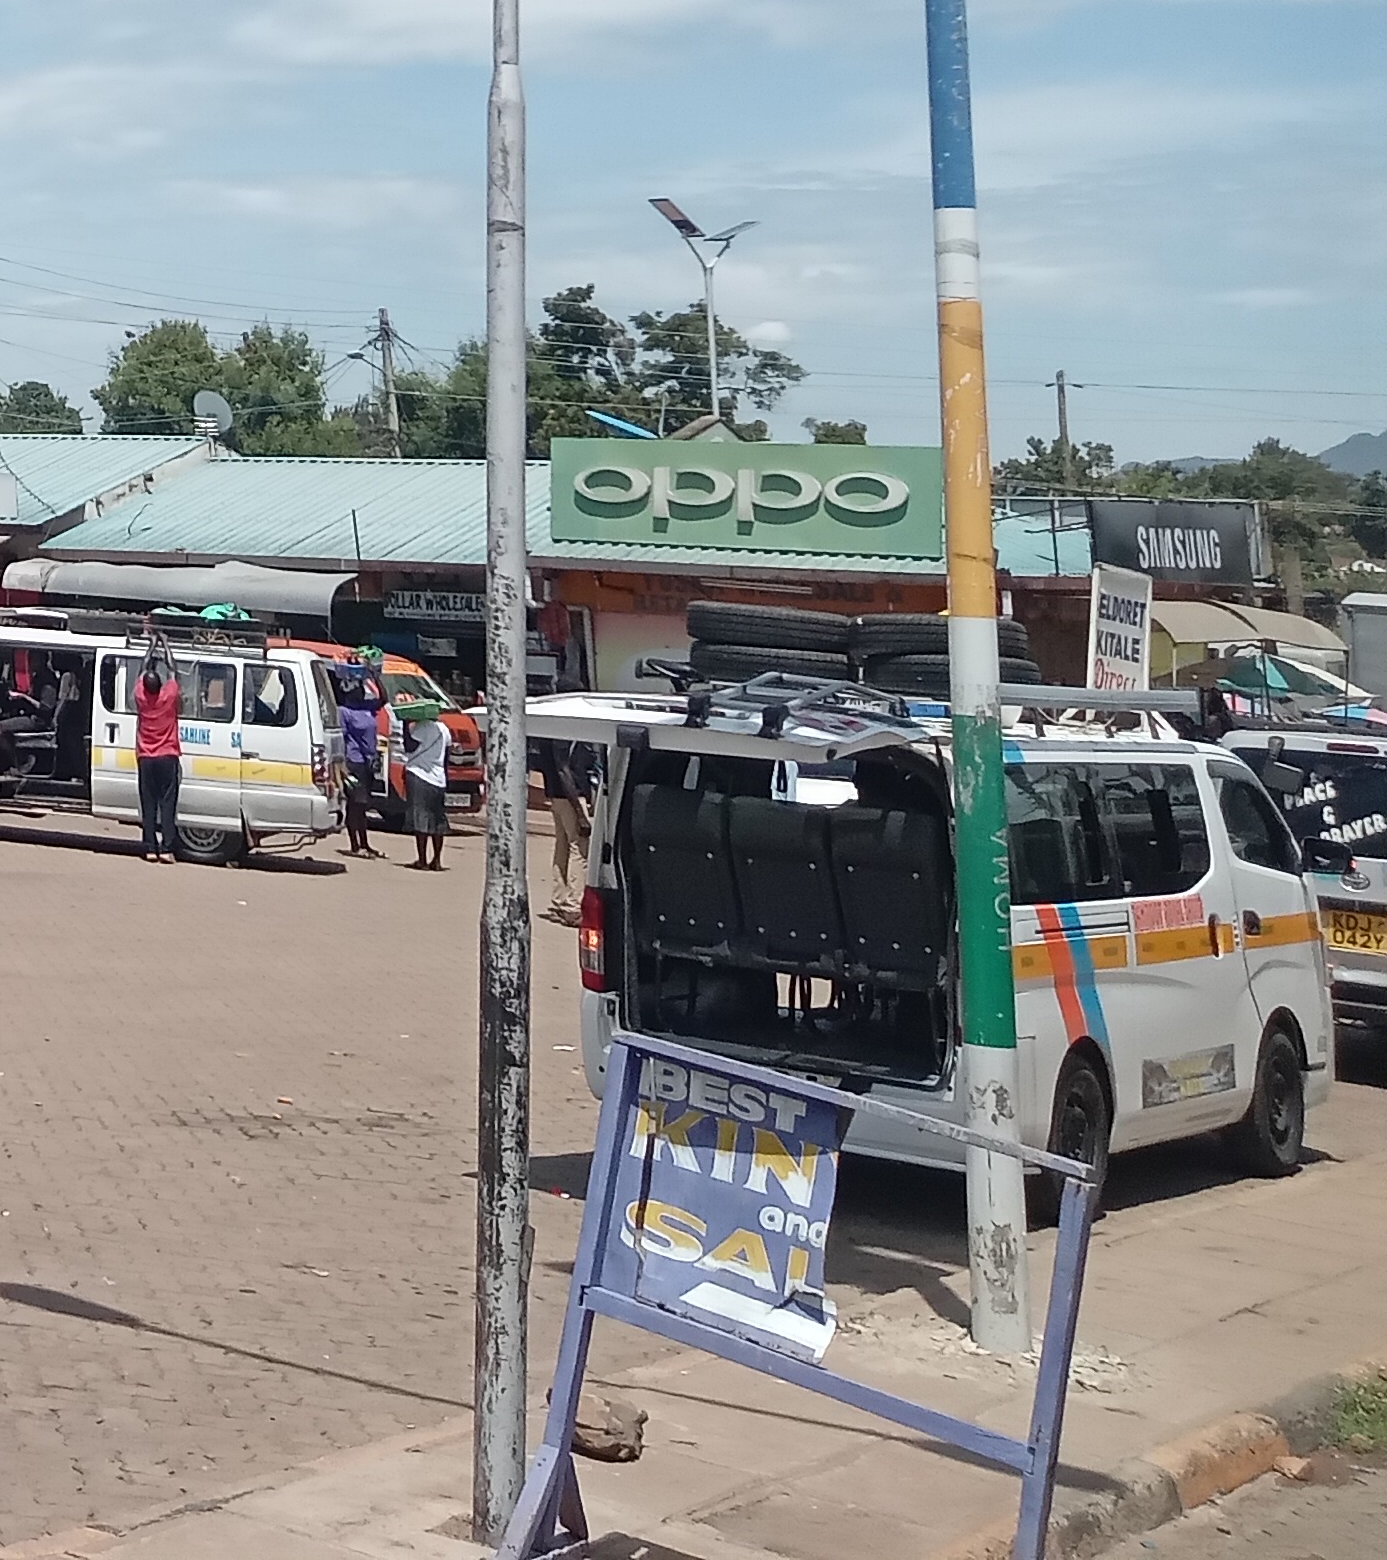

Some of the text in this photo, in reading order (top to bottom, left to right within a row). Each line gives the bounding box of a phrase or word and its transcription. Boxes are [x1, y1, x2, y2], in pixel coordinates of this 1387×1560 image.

[1137, 525, 1221, 569] SAMSUNG
[384, 592, 423, 609] OLLAR
[1098, 593, 1146, 628] ELDORET
[1096, 629, 1141, 663] KITALE
[1332, 912, 1372, 932] KDJ
[1333, 929, 1384, 949] 042Y
[638, 1059, 807, 1133] BEST
[628, 1100, 839, 1209] KIN
